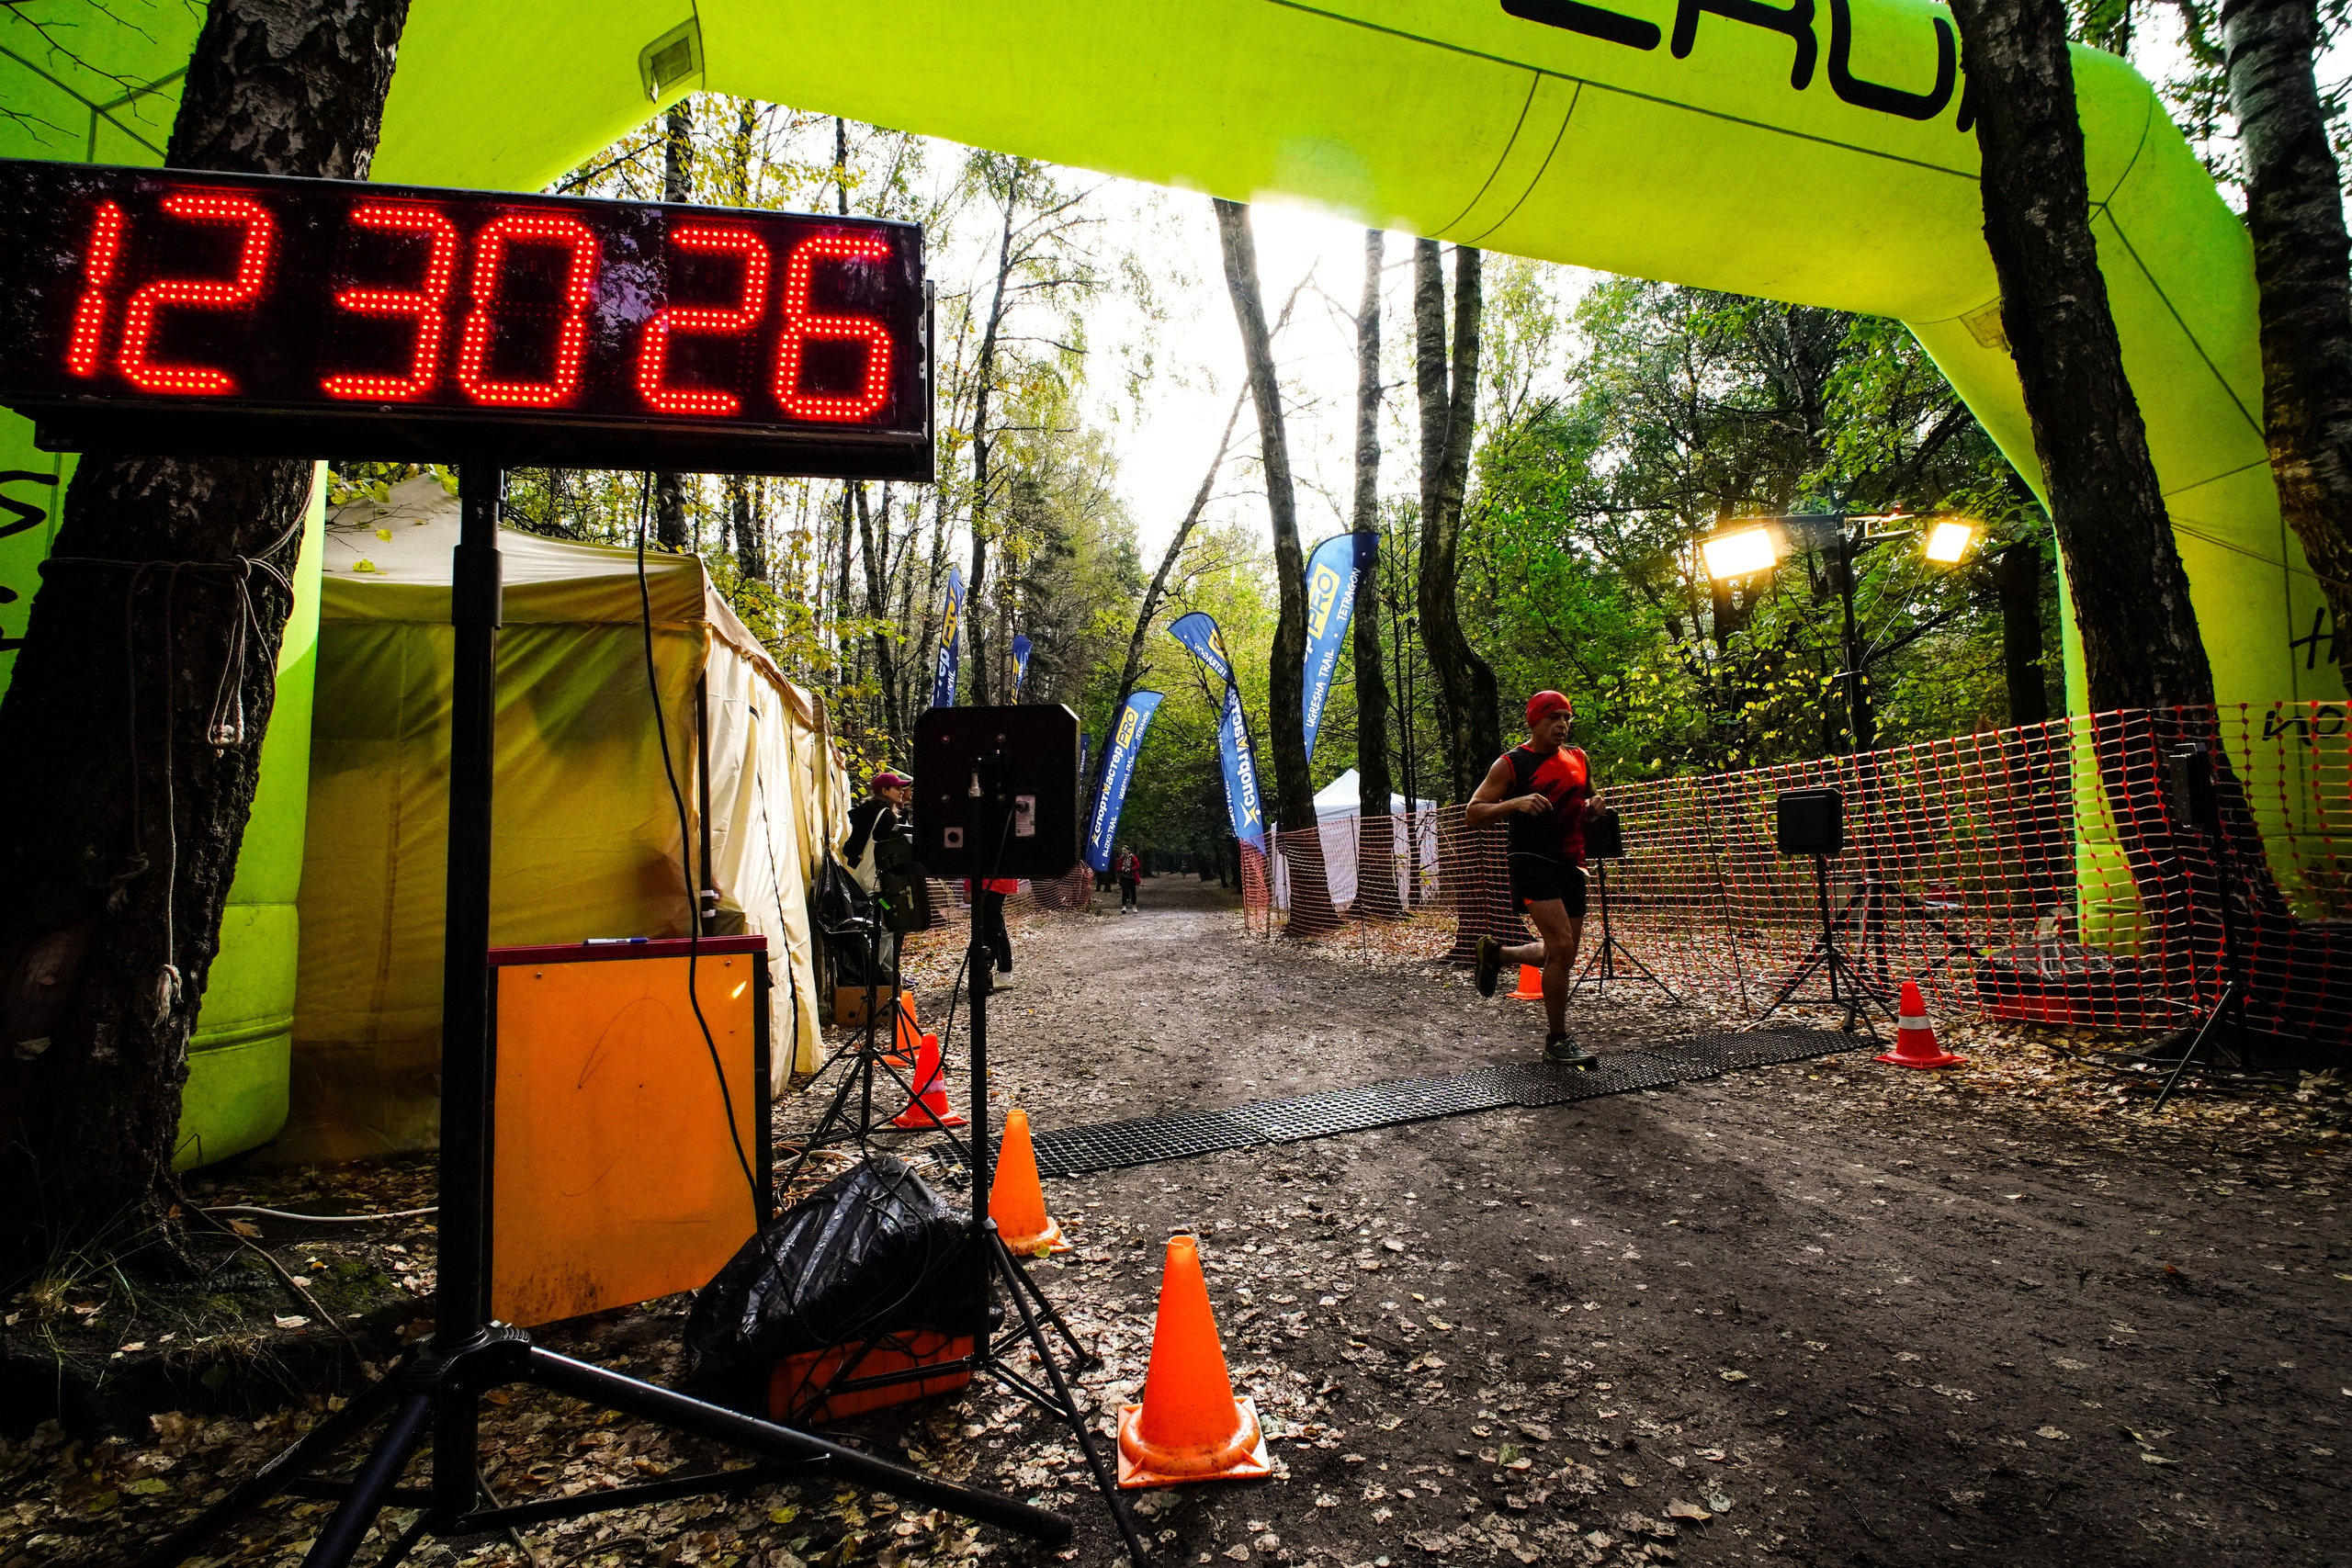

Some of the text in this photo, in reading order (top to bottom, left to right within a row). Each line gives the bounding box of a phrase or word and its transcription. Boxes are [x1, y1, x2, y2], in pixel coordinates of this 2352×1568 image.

[69, 196, 889, 420] 12 30 26
[1307, 572, 1334, 633] PRO
[1336, 567, 1362, 621] TETRAGON
[1306, 681, 1327, 728] UGRESHA
[1317, 649, 1334, 677] TRAIL
[1118, 711, 1136, 746] PRO
[1135, 710, 1151, 741] TETRAGON
[1125, 755, 1135, 772] TRAIL
[1102, 815, 1117, 858] BLIZKO TRAIL
